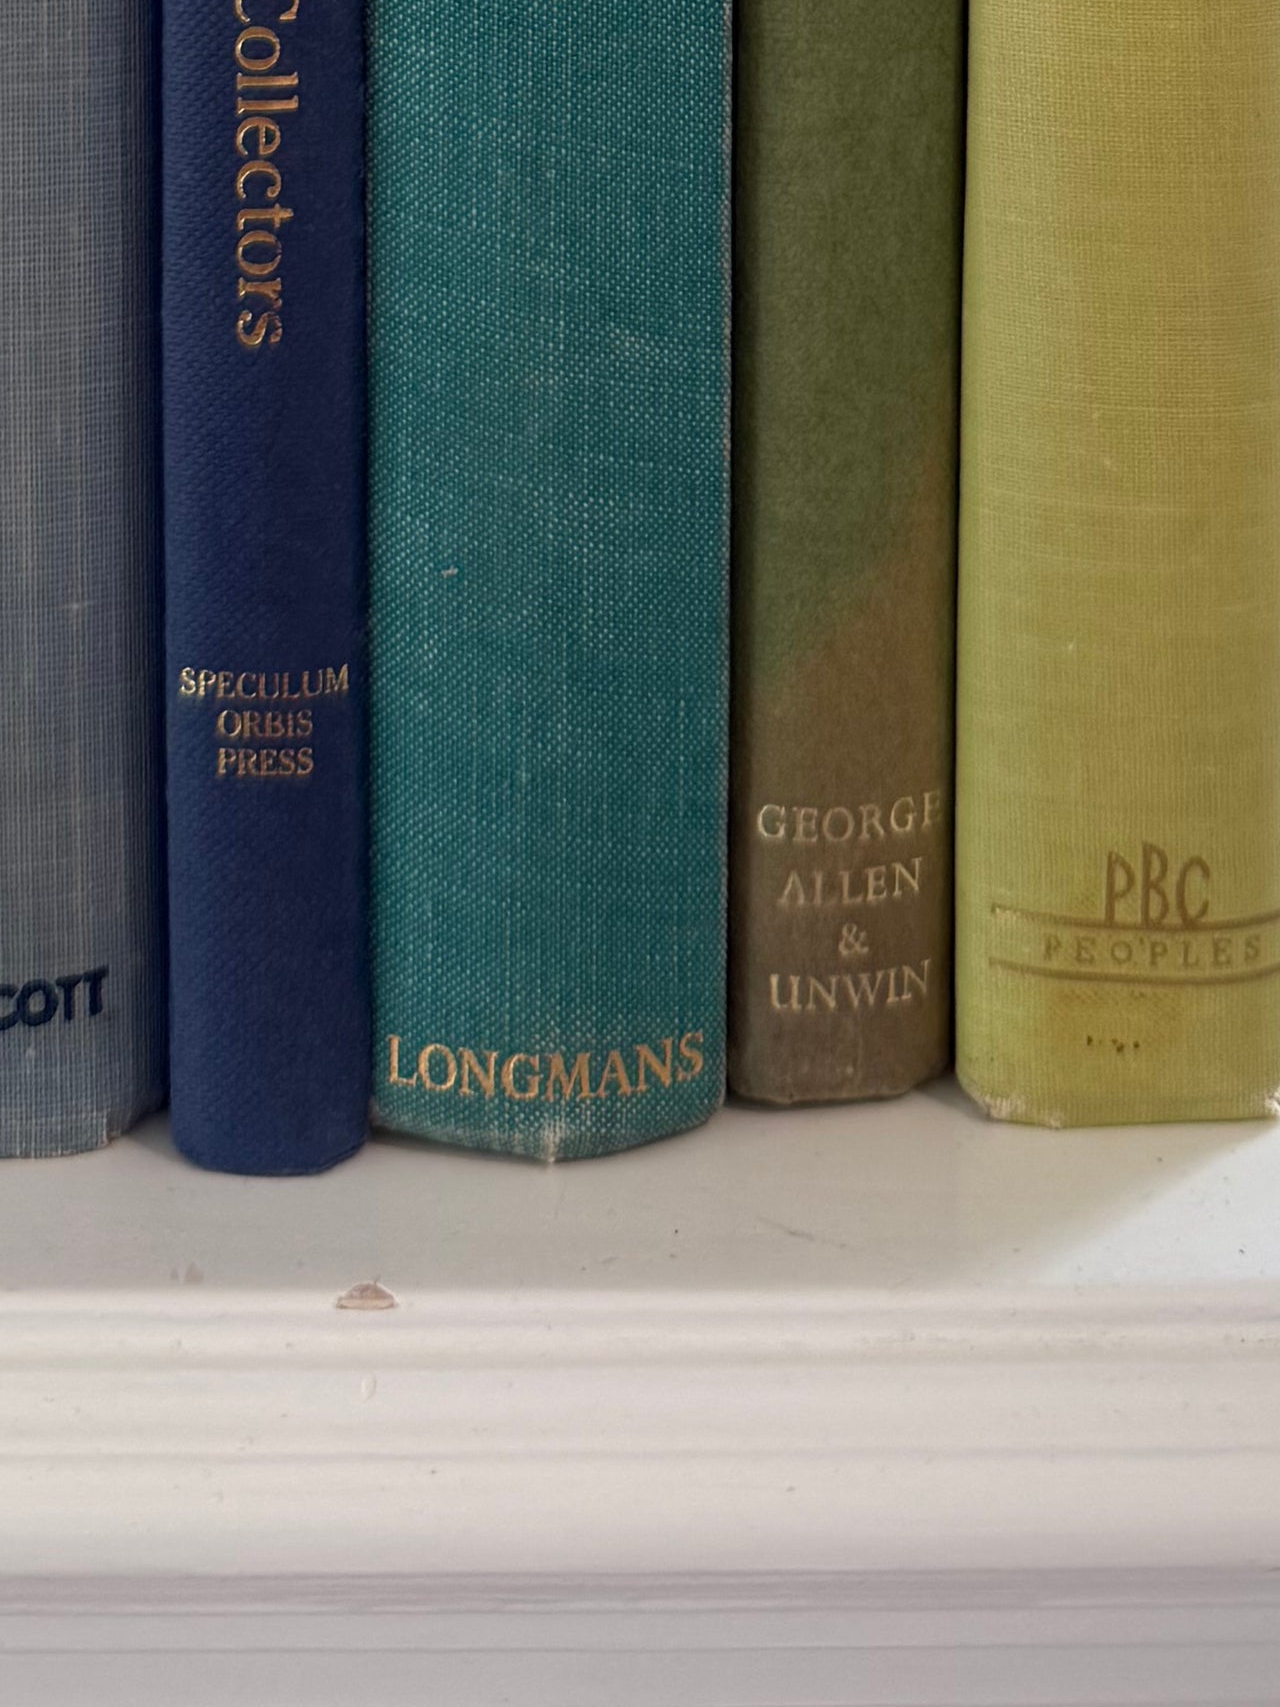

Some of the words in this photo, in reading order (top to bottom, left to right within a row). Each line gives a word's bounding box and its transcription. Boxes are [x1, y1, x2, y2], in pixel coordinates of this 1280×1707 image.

[179, 663, 350, 700] SPECULUM
[216, 709, 314, 739] ORBIS
[217, 747, 315, 777] PRESS
[777, 857, 923, 907] ALLEN
[1103, 840, 1211, 929] PBC
[837, 922, 870, 956] &
[769, 958, 932, 1012] UNWIN
[387, 1032, 705, 1102] LONGMANS
